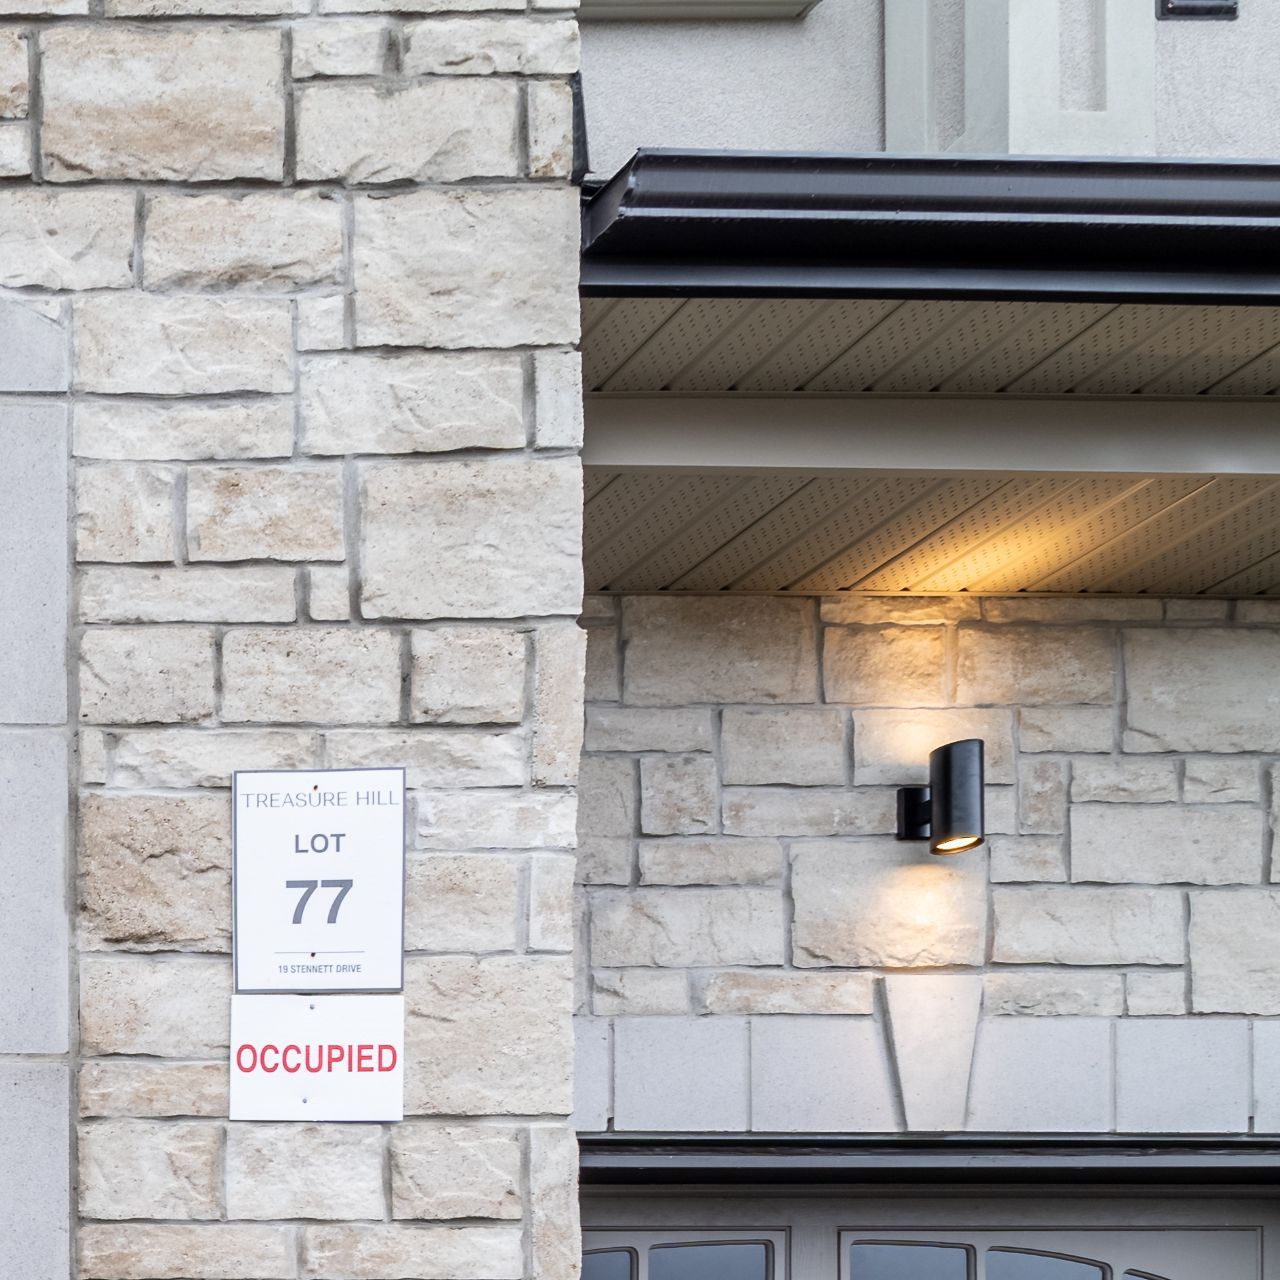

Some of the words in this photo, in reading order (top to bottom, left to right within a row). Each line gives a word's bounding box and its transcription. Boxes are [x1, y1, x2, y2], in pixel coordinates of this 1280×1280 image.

[240, 791, 348, 809] TREASURE
[356, 790, 401, 806] HILL
[295, 833, 346, 853] LOT
[285, 879, 354, 924] 77
[278, 965, 289, 974] 19
[290, 964, 333, 974] STENNETT
[336, 964, 362, 973] DRIVE
[236, 1043, 398, 1074] OCCUPIED
